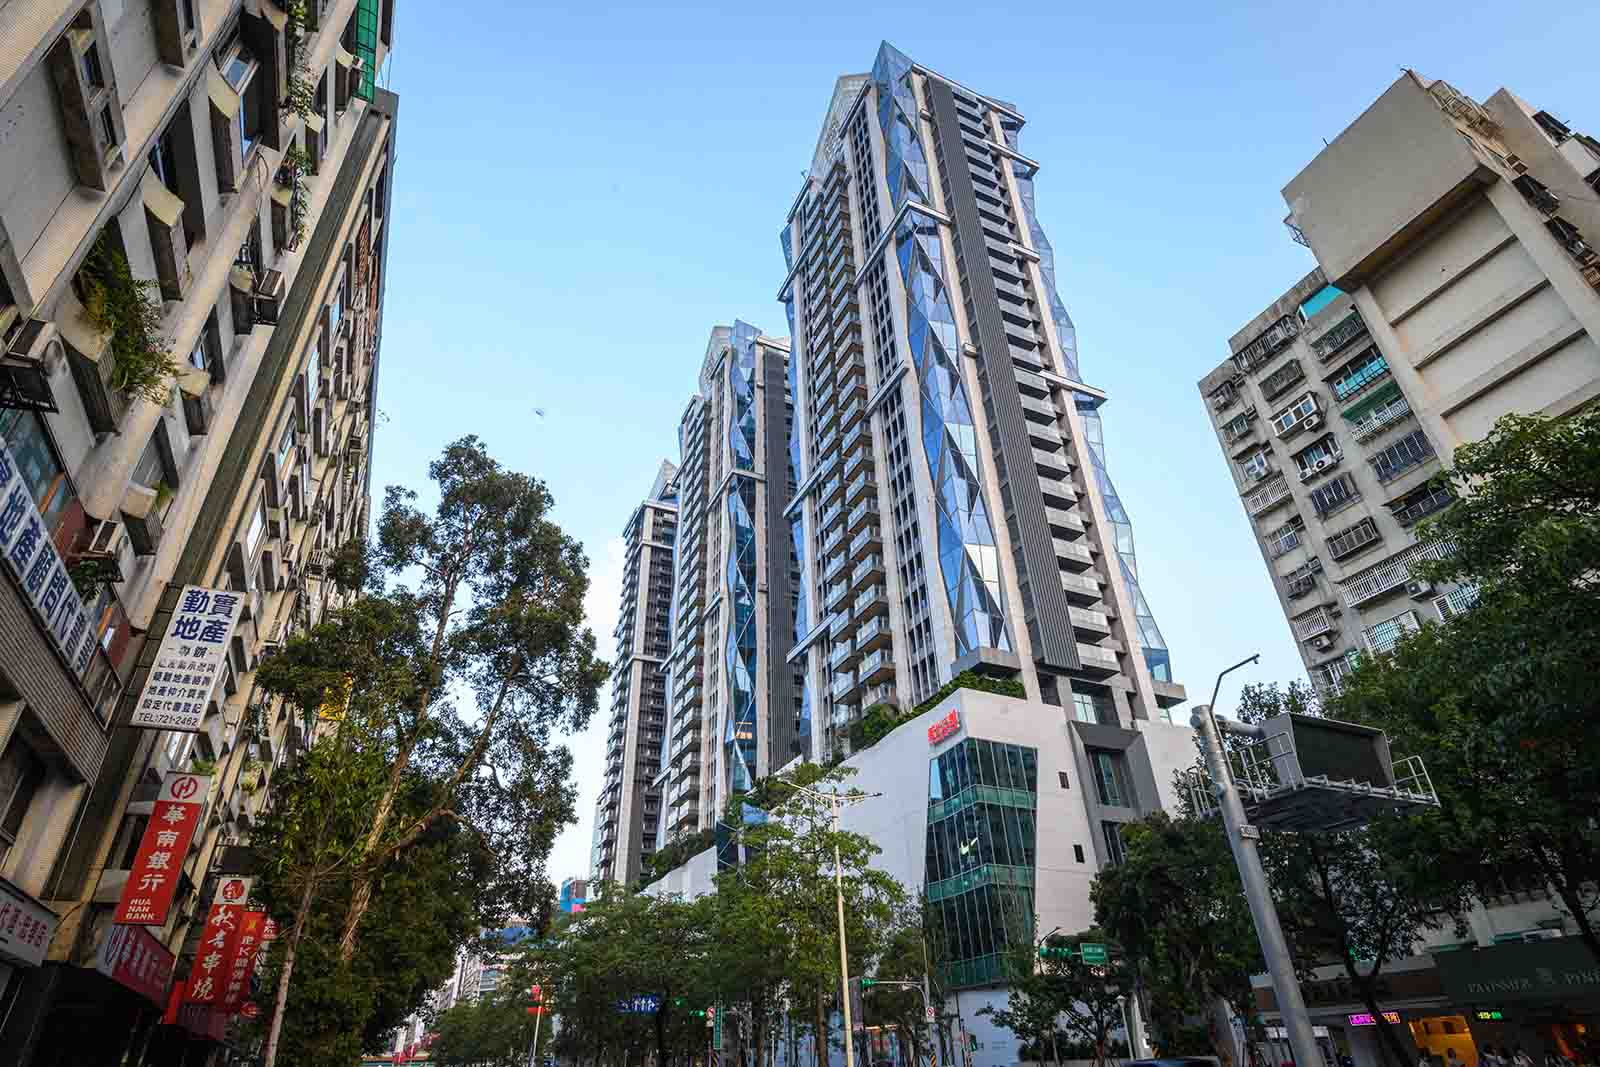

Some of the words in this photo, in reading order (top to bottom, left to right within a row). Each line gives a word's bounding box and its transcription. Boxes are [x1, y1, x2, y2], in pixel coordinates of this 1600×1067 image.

[170, 615, 230, 644] 地產
[138, 804, 186, 892] 華南銀行
[130, 898, 152, 906] HUA
[126, 912, 155, 920] BANK
